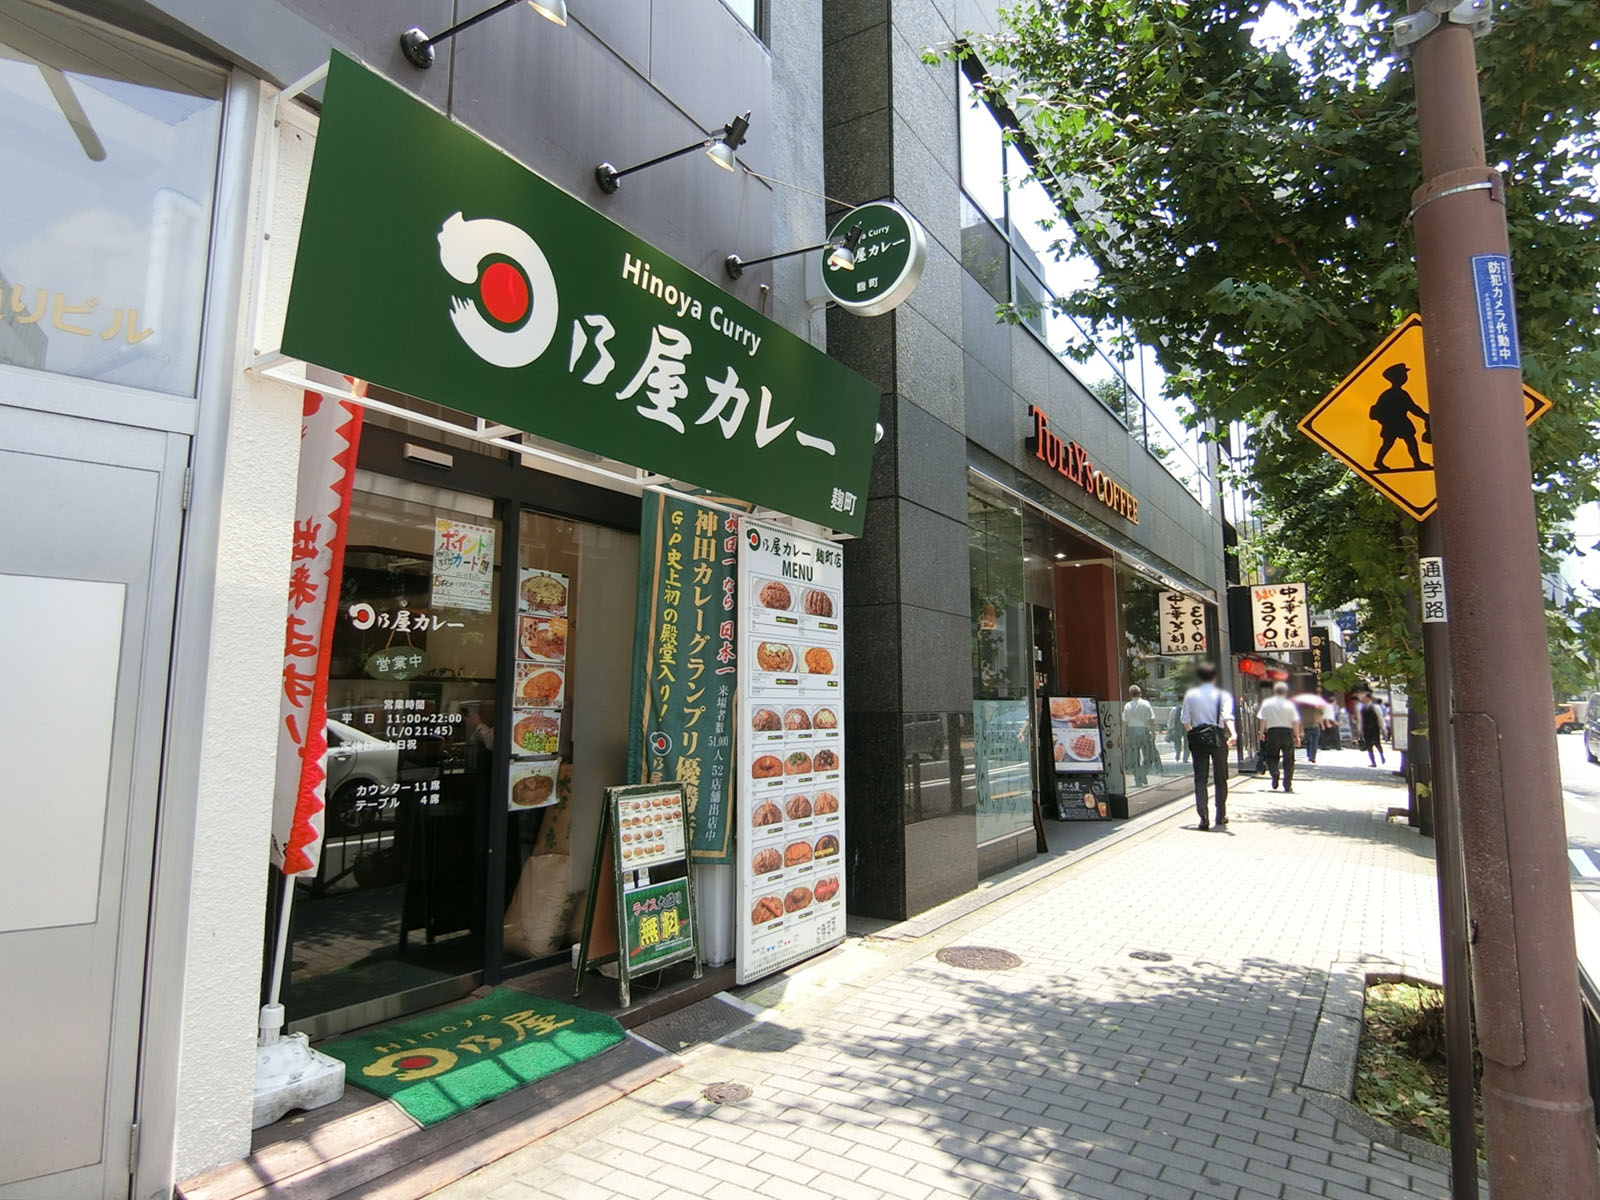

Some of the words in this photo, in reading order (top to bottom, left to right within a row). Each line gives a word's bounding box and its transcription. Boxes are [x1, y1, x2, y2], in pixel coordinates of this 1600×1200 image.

[0, 283, 154, 344] りビル
[622, 252, 704, 322] Hinoya
[709, 306, 763, 357] Curry
[1488, 261, 1511, 360] 防犯カメラ作動中
[1093, 470, 1139, 526] COFFEE
[782, 560, 813, 582] MENU
[1420, 560, 1445, 619] 通学路
[1279, 586, 1303, 640] 中華そば
[376, 654, 422, 672] 営業中
[384, 699, 425, 710] 営業時間
[640, 907, 680, 948] 無料
